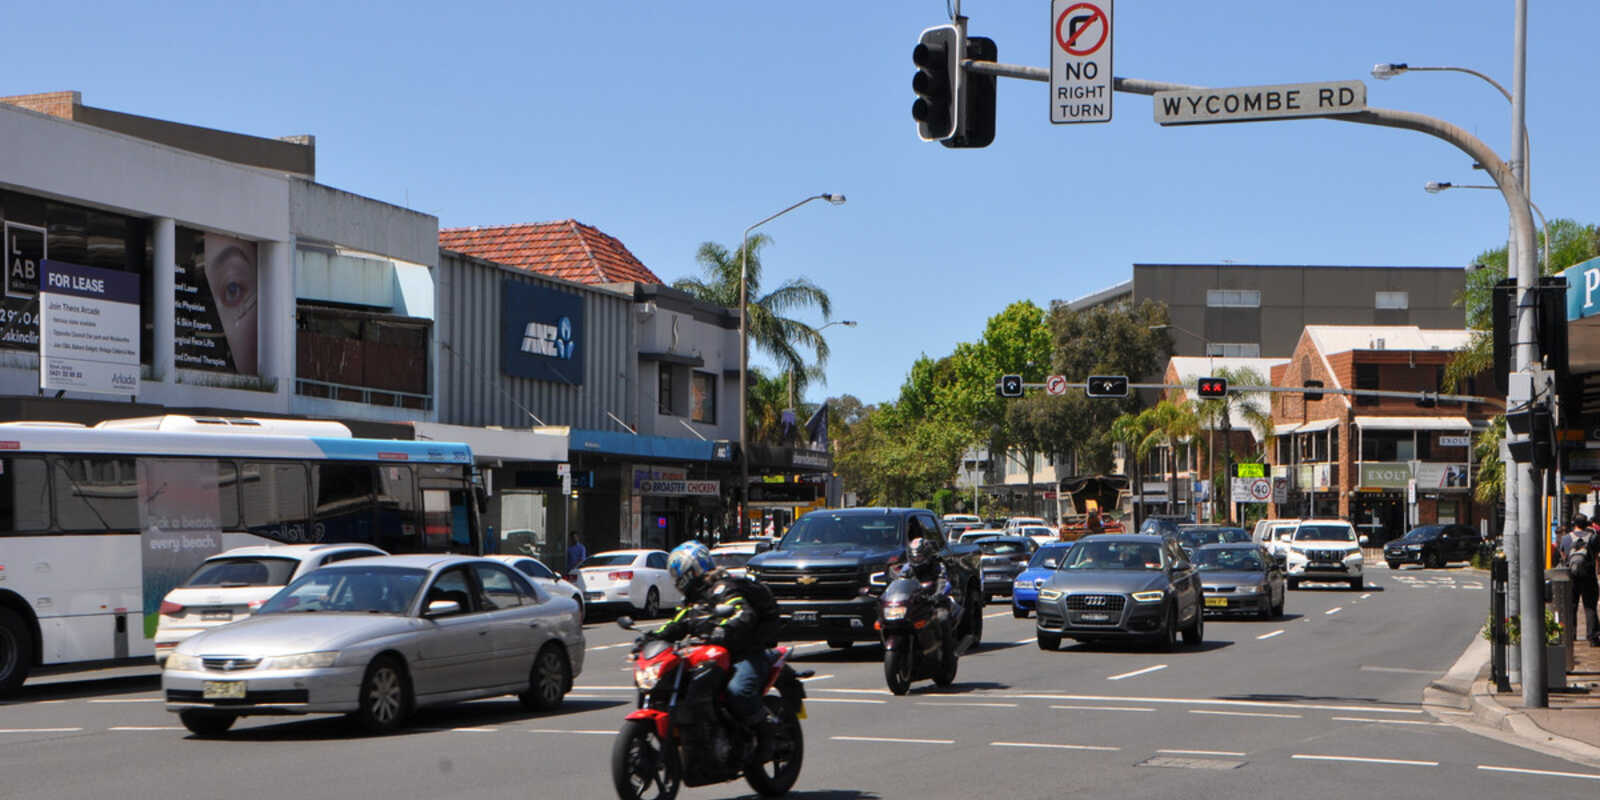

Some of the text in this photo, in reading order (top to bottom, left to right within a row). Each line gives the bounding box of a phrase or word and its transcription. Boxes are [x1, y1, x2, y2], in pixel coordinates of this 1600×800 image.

[1066, 61, 1098, 80] NO
[1058, 85, 1105, 99] RIGHT
[1162, 87, 1355, 115] WYCOMBE RD
[1060, 104, 1104, 117] TURN
[48, 272, 70, 289] FOR
[72, 276, 104, 293] LEASE
[1368, 470, 1408, 481] EXOLT
[687, 482, 717, 493] CHICKEN
[1254, 484, 1268, 494] 40
[150, 538, 180, 552] every
